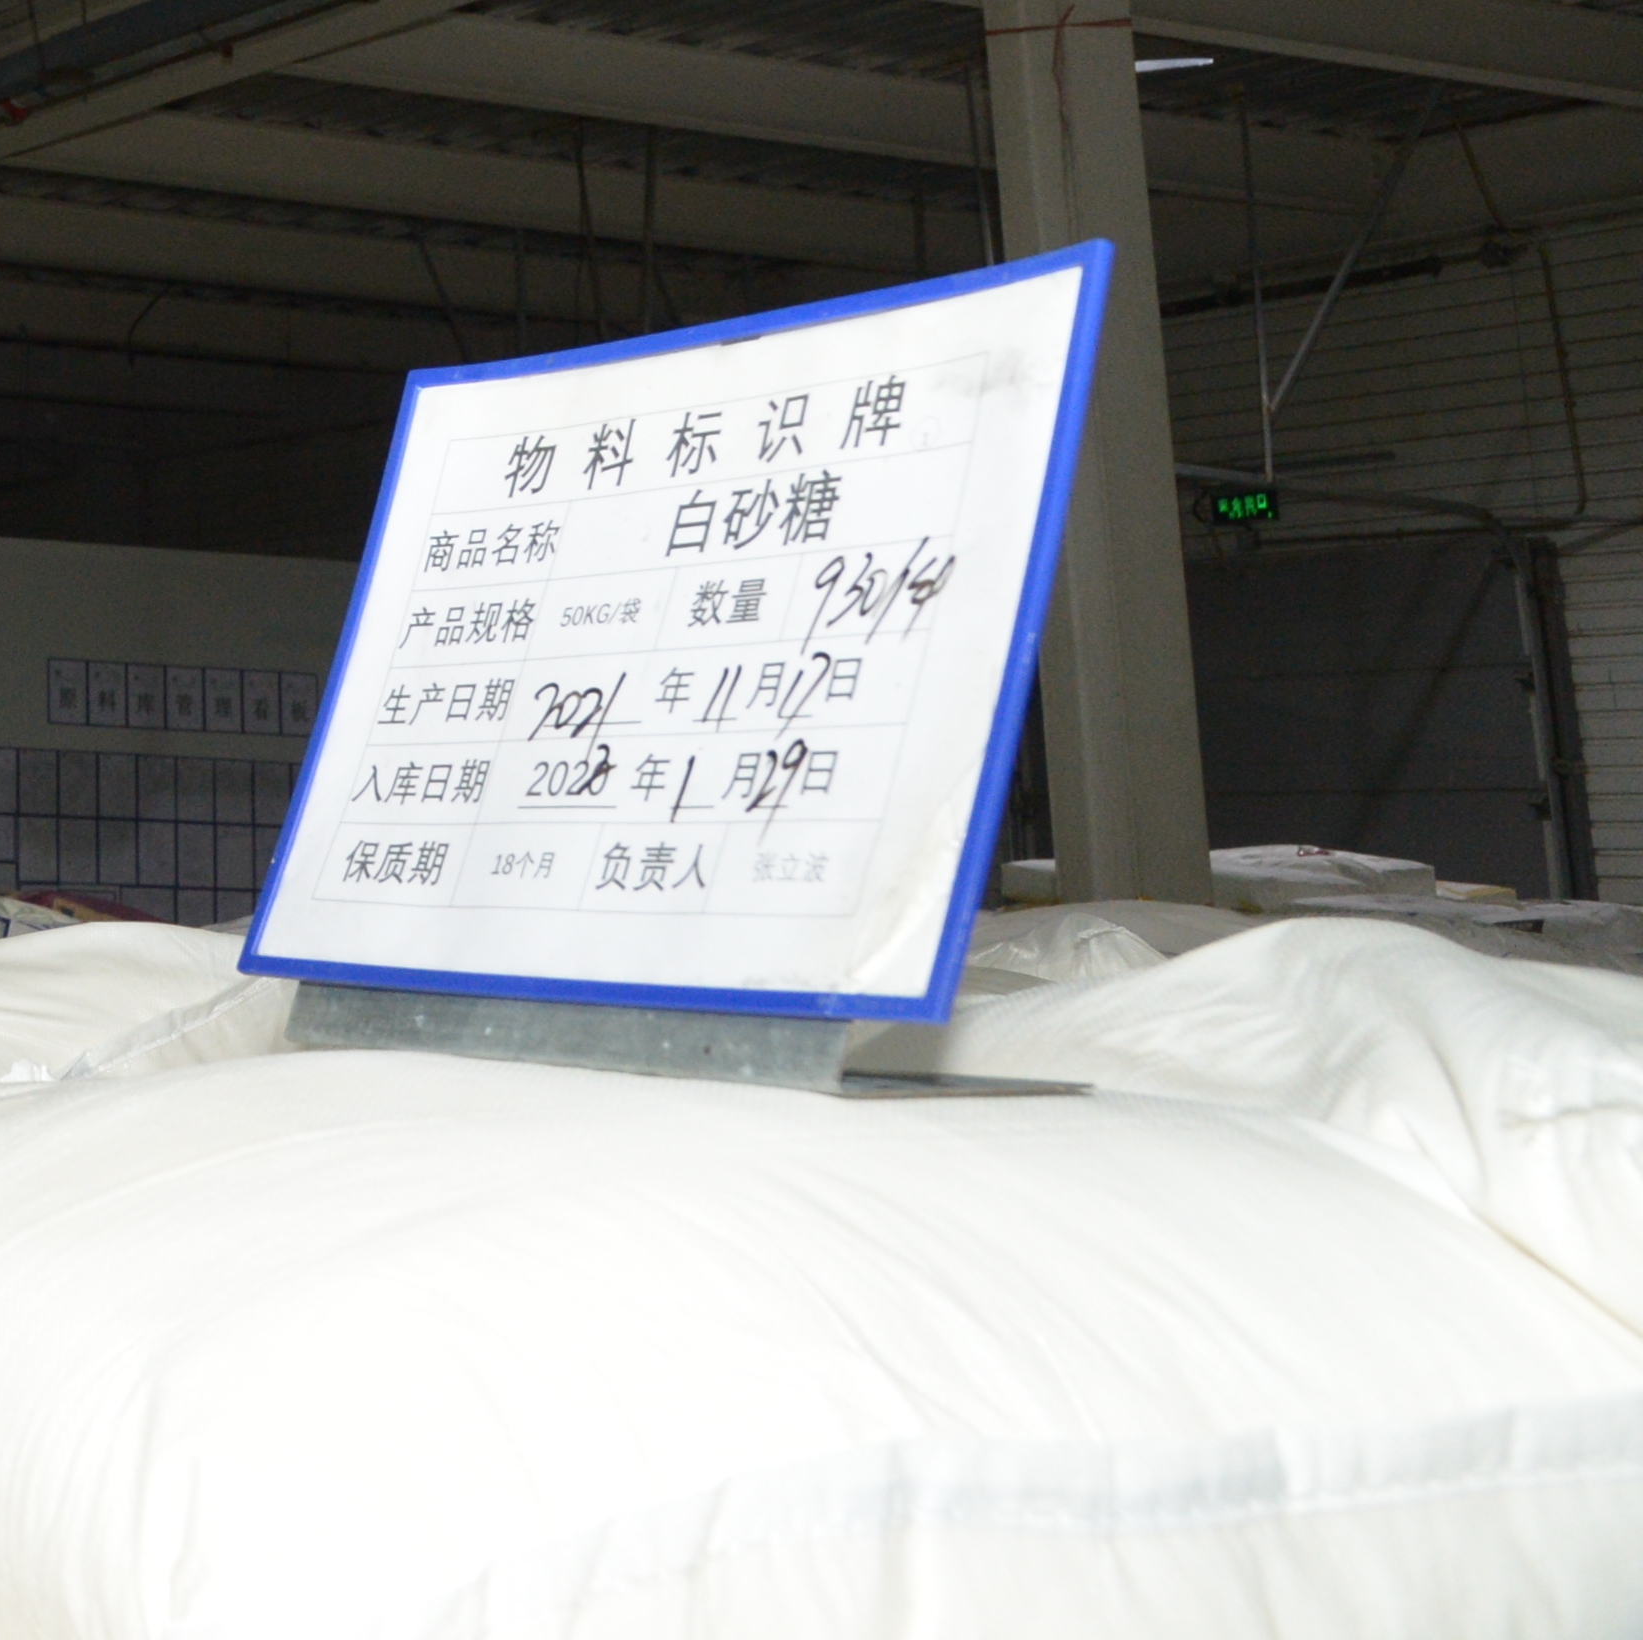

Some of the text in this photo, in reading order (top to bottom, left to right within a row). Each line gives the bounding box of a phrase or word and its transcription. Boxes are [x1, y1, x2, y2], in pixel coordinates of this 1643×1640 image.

[504, 374, 907, 499] 物料标识牌
[423, 468, 843, 573] 商品名称 白砂糖
[398, 597, 537, 650] 产品规格
[559, 597, 643, 628] 50KG/袋
[686, 577, 767, 628] 数量
[376, 677, 516, 727] 生产日期
[350, 758, 491, 805] 入库日期
[342, 839, 450, 886] 保质期
[490, 851, 556, 879] 18个月
[595, 841, 706, 892] 负责人
